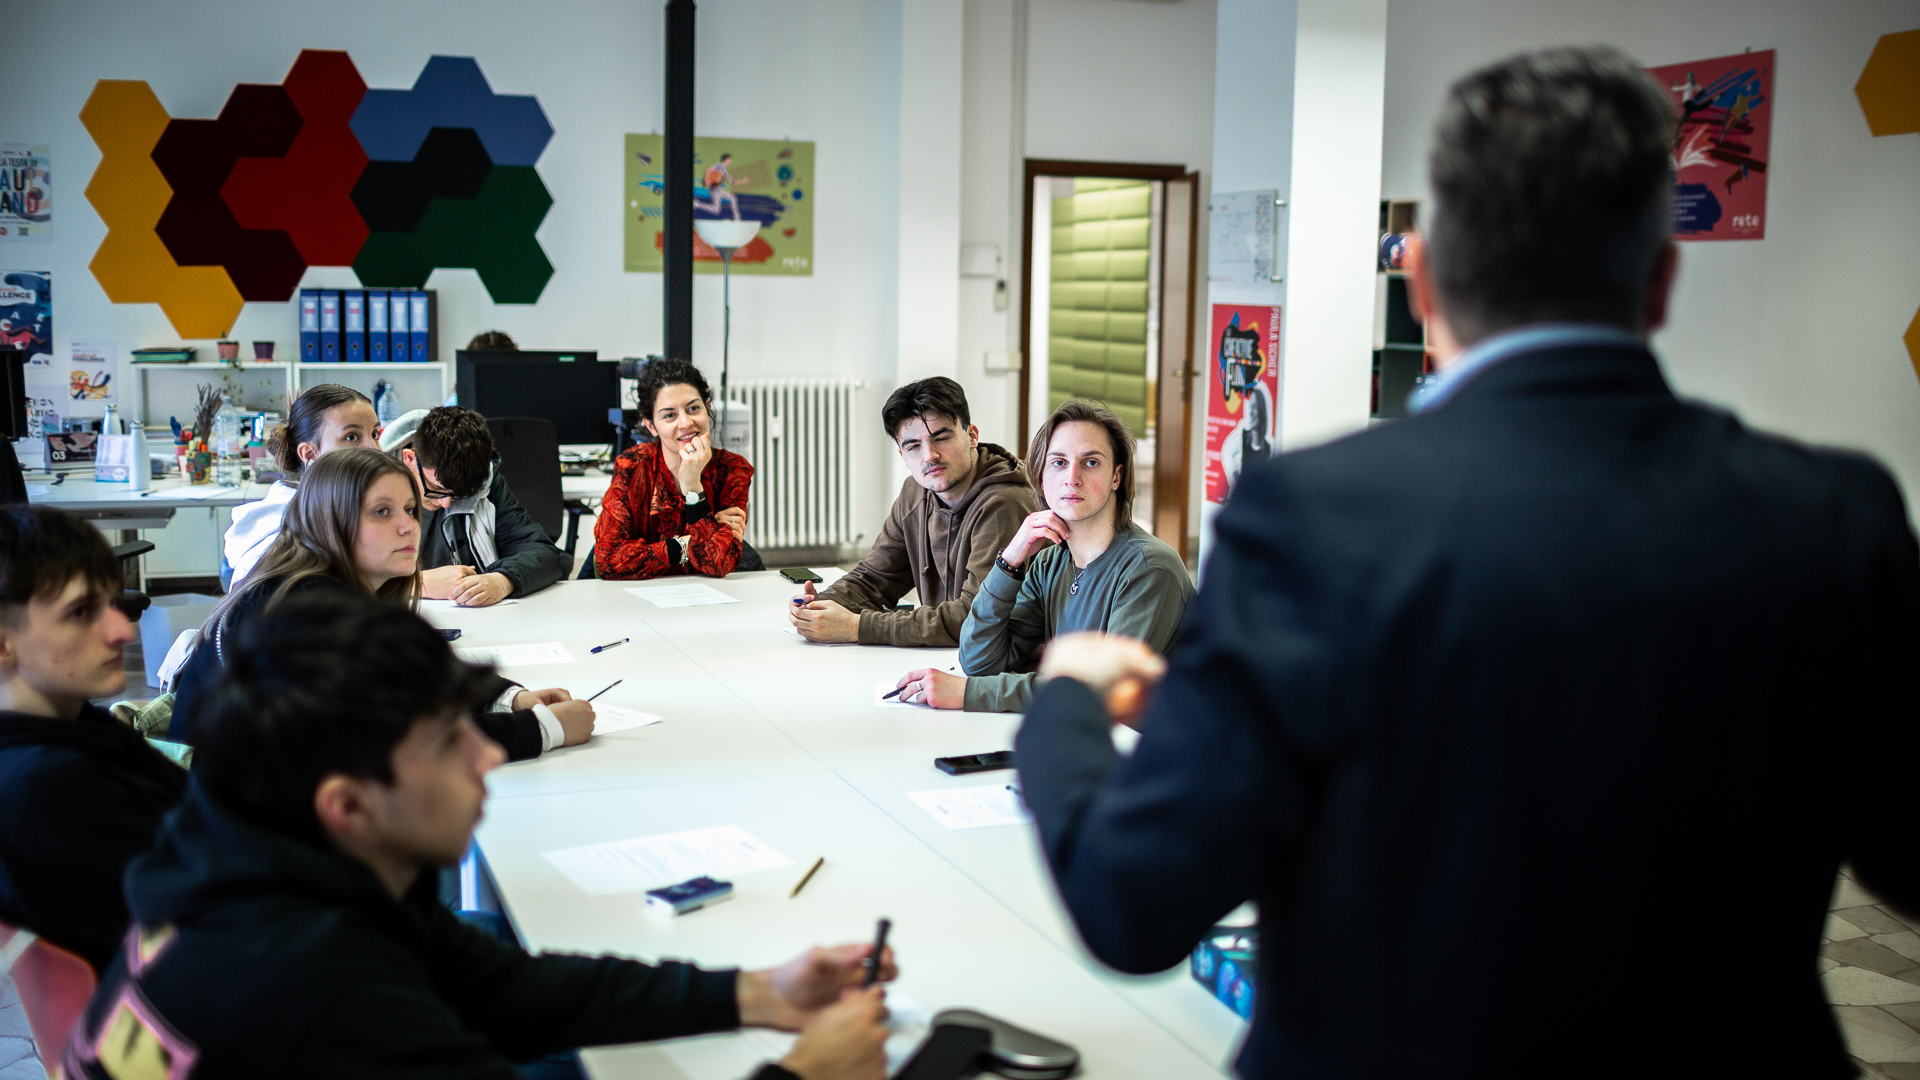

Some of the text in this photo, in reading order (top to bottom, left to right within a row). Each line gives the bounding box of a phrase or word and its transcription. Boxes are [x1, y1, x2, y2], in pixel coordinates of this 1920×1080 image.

[8, 158, 28, 166] TESTA
[1732, 214, 1760, 227] rete
[52, 450, 66, 460] 03
